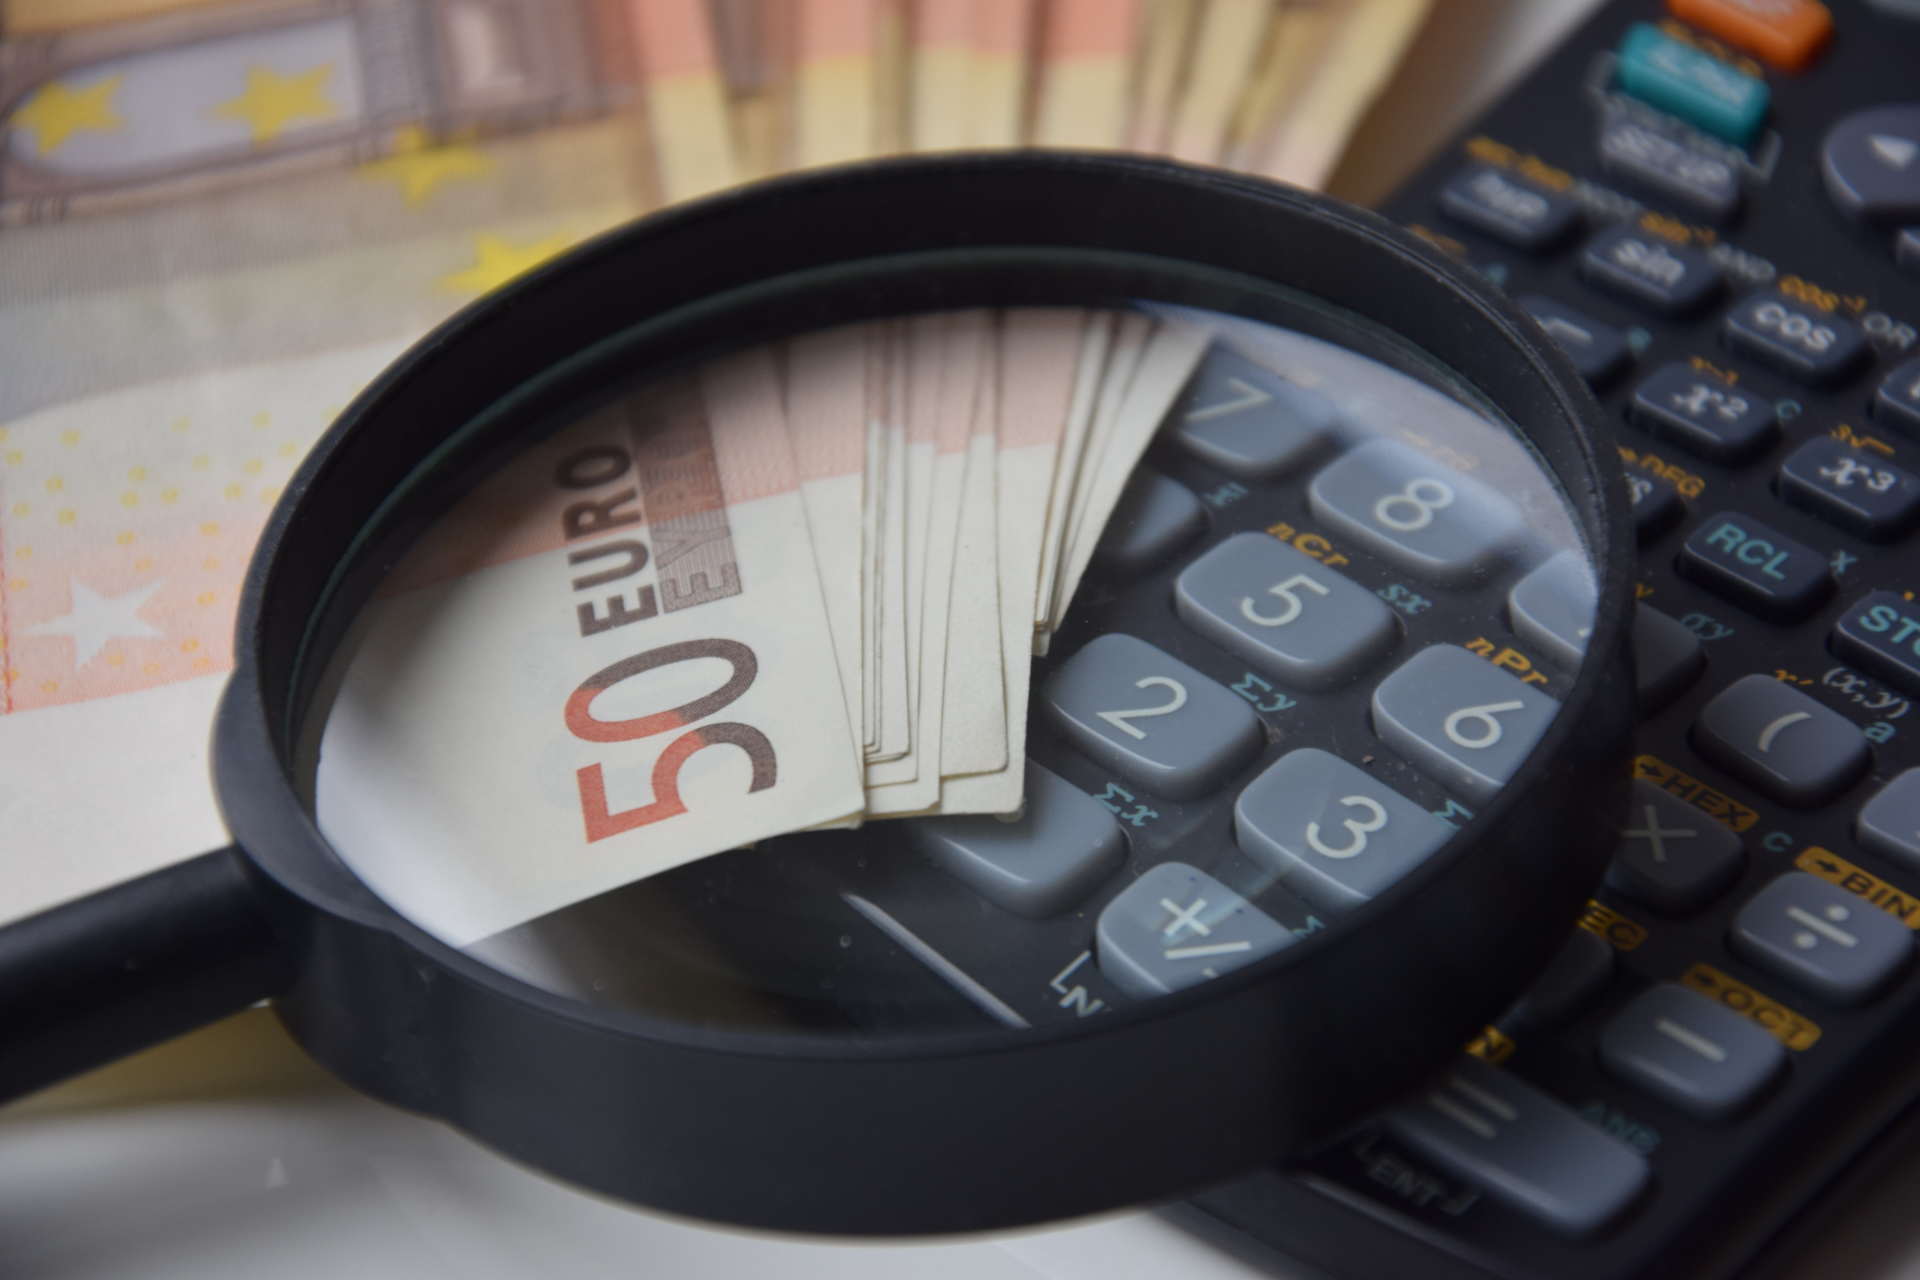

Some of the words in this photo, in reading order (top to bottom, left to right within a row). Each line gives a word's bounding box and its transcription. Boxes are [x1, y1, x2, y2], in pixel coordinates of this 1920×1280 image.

[1755, 302, 1836, 350] cos
[1185, 379, 1272, 422] 7
[1375, 477, 1454, 531] 8
[554, 443, 659, 638] EURO
[1265, 522, 1350, 566] nCr
[1705, 523, 1790, 580] RCL
[1241, 574, 1331, 627] 5
[1464, 636, 1549, 687] nPr
[1096, 676, 1188, 741] 2
[1443, 700, 1525, 749] 6
[1863, 721, 1896, 744] a
[563, 637, 778, 844] 50
[1306, 795, 1388, 859] 3
[1659, 773, 1751, 830] HEX
[1839, 872, 1920, 922] BIN
